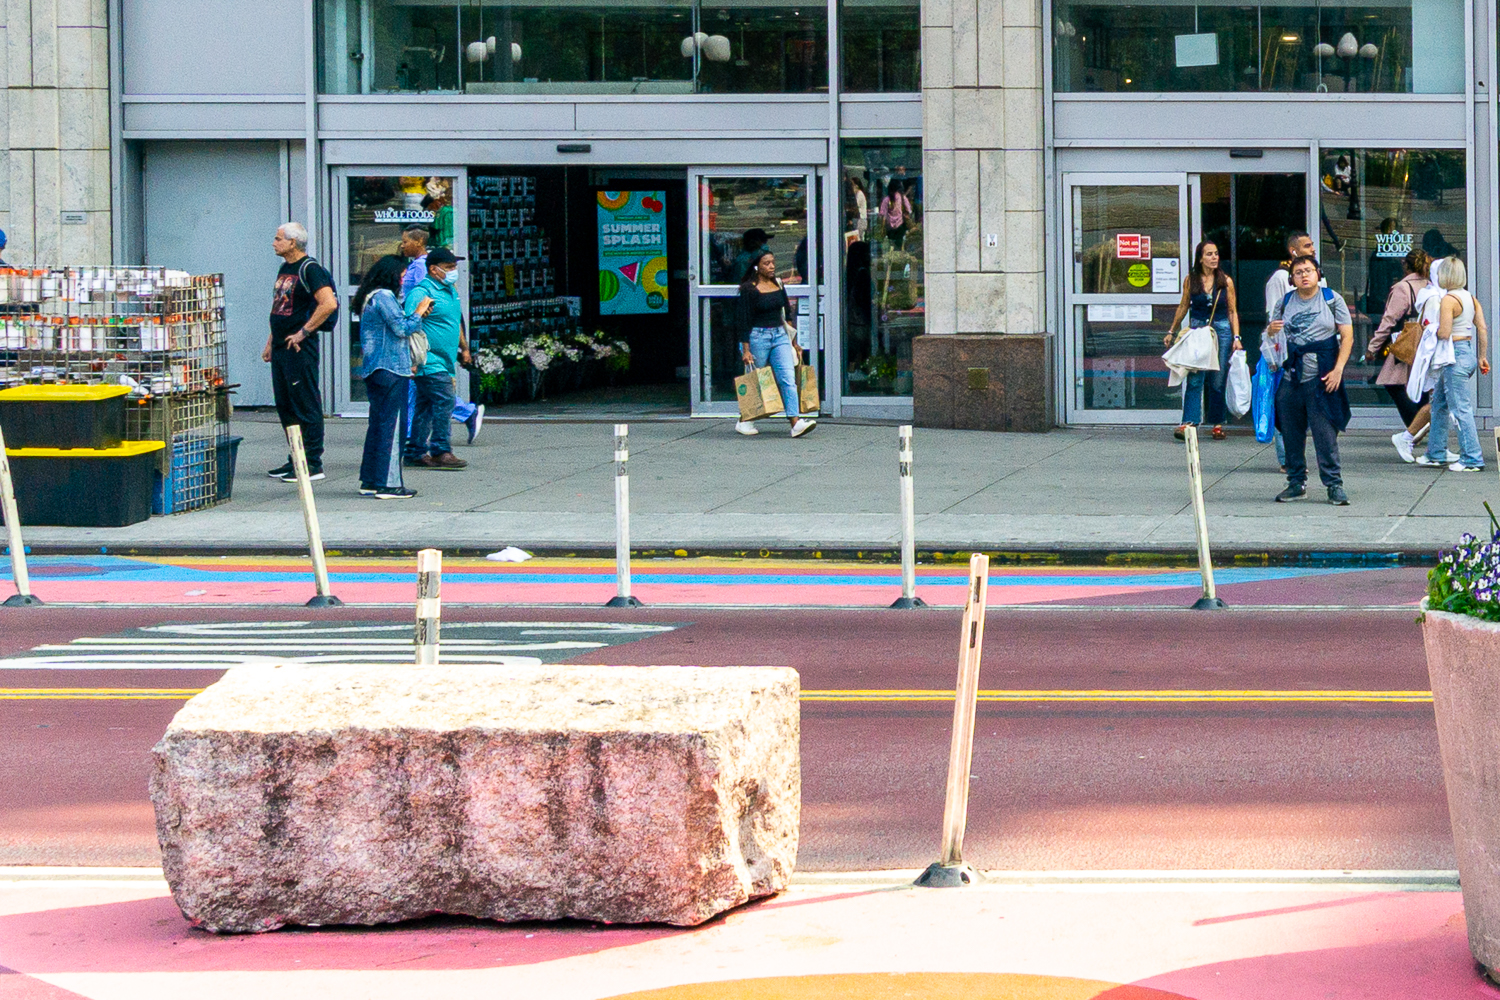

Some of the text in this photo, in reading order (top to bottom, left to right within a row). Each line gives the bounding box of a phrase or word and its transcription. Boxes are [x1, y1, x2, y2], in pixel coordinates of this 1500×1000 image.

[374, 208, 406, 218] WHOLE
[602, 223, 660, 233] SUMMER
[603, 234, 661, 245] SPLASH
[1375, 232, 1414, 243] WHOLE
[1377, 243, 1412, 253] FOODS
